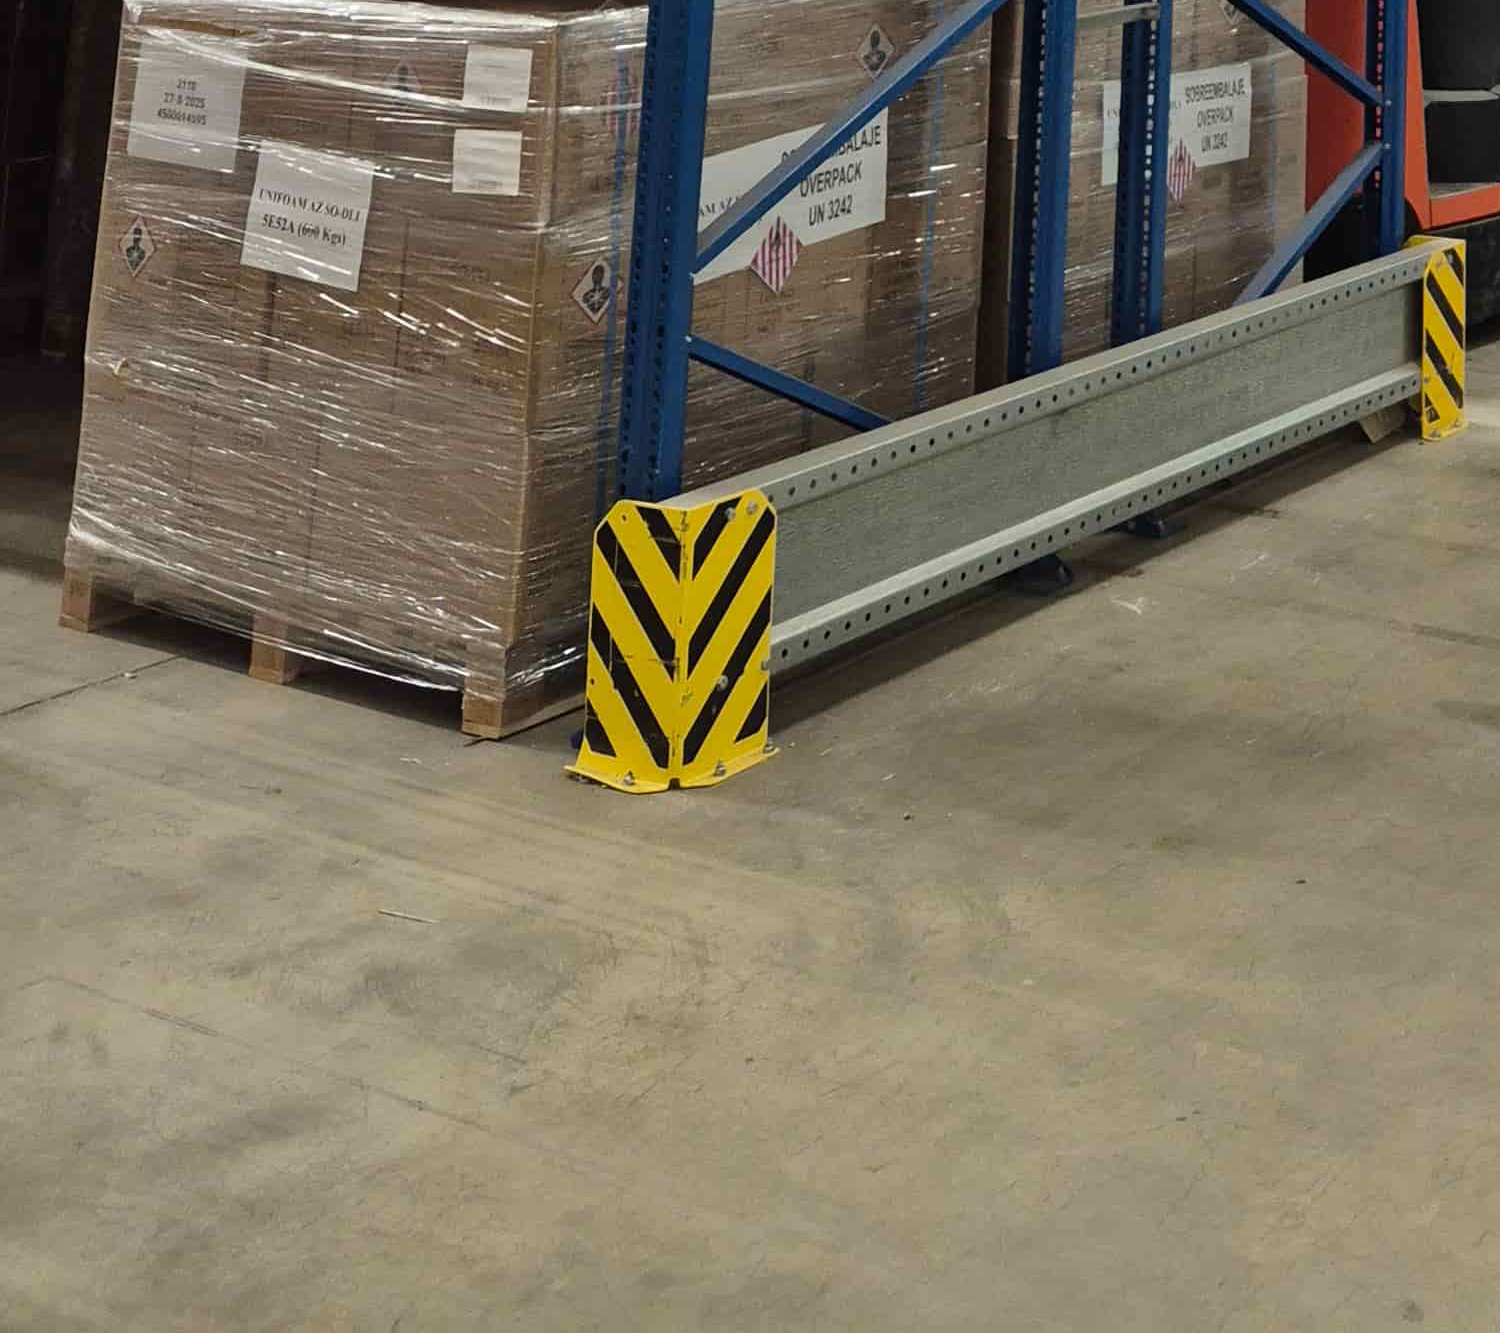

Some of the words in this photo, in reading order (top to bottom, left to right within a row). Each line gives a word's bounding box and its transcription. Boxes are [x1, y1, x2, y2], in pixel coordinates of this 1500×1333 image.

[1184, 78, 1247, 104] SOBREEMBALAJE
[799, 161, 863, 198] OVERPACK
[259, 188, 308, 211] UNIFOAM
[808, 204, 825, 227] UN
[827, 194, 853, 220] 3242
